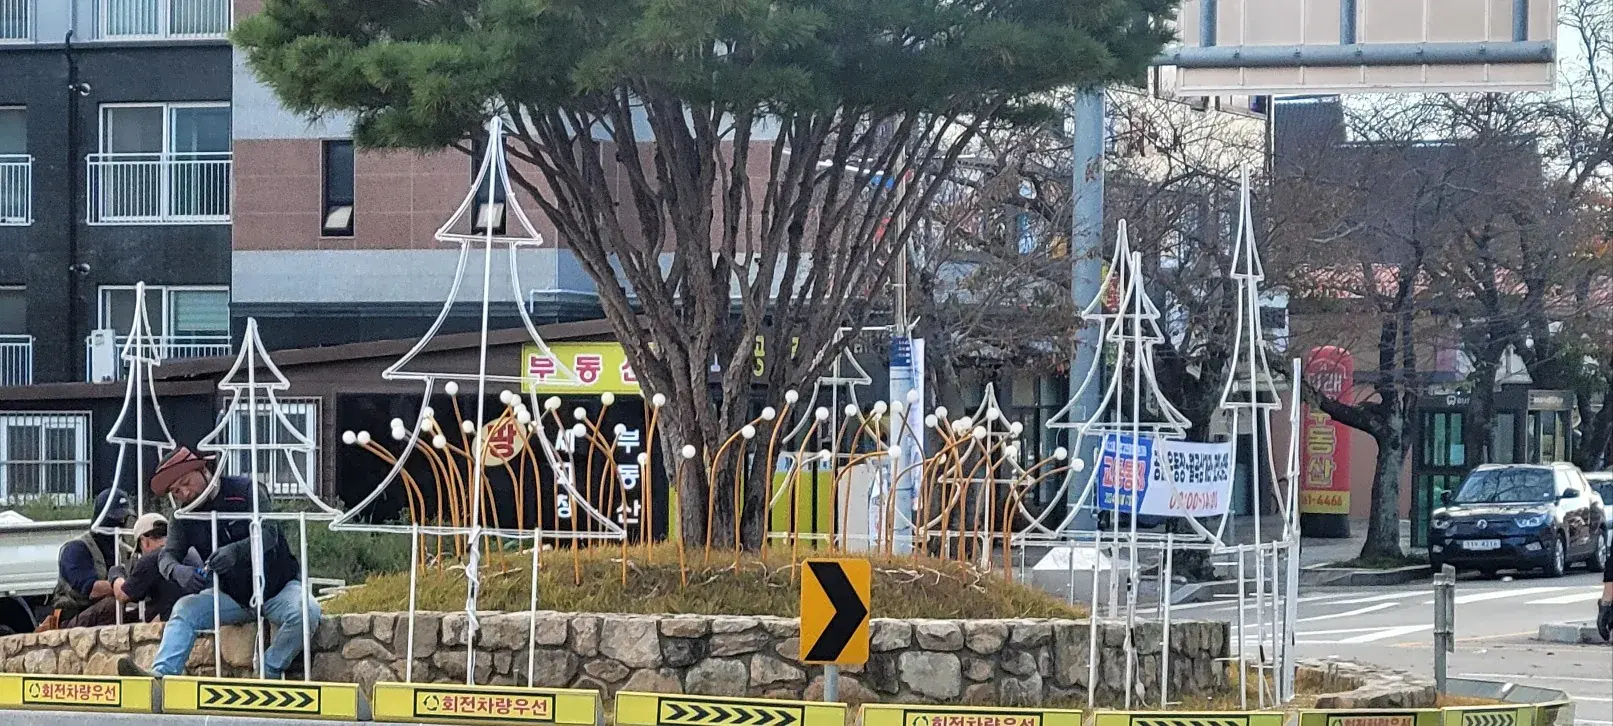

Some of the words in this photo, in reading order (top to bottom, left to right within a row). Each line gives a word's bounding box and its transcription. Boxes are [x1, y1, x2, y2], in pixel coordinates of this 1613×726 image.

[615, 428, 642, 524] 부동산
[42, 683, 116, 701] 회전차량우선
[441, 695, 548, 716] 회전차량우선
